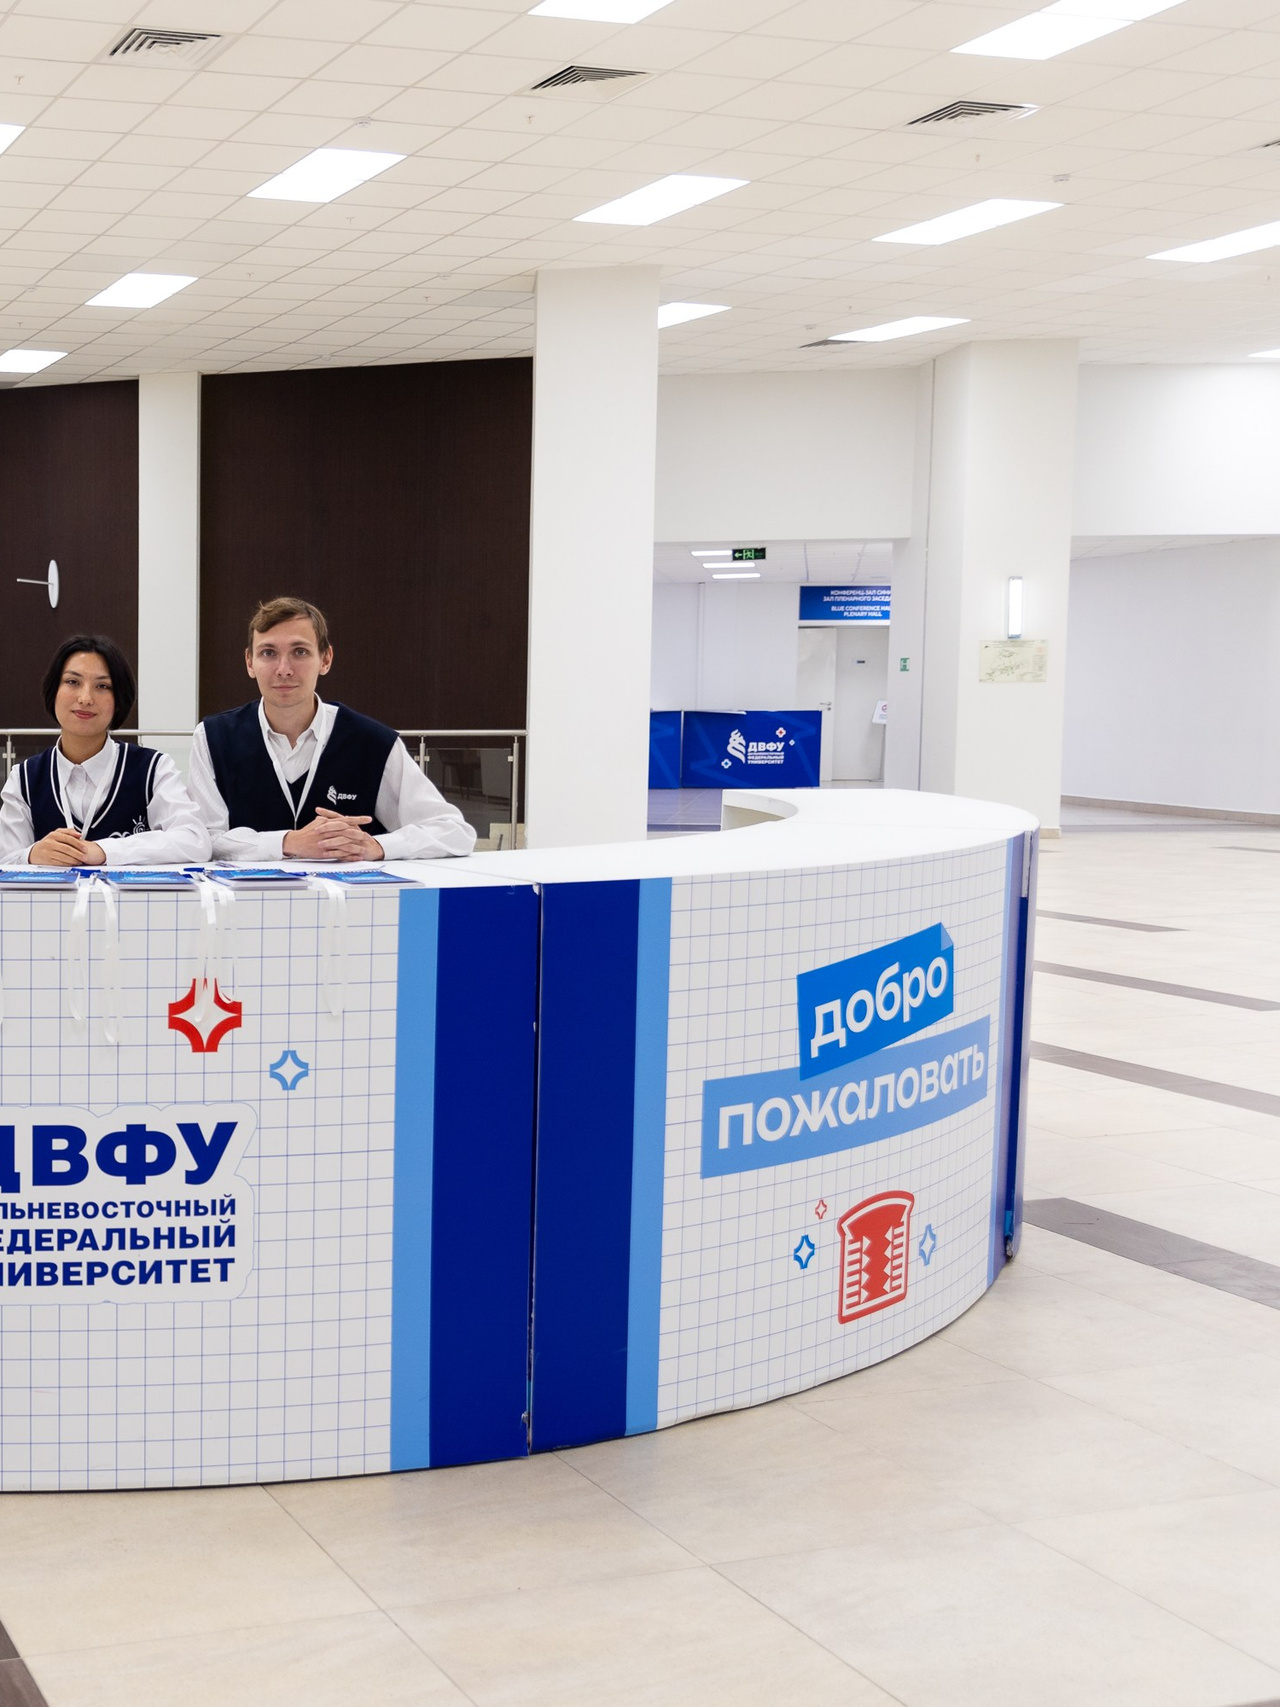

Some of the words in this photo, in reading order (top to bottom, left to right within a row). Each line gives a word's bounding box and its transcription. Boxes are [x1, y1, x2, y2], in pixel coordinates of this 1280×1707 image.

[748, 742, 785, 752] ДВФУ
[810, 956, 948, 1058] добро
[718, 1042, 985, 1150] пожаловать
